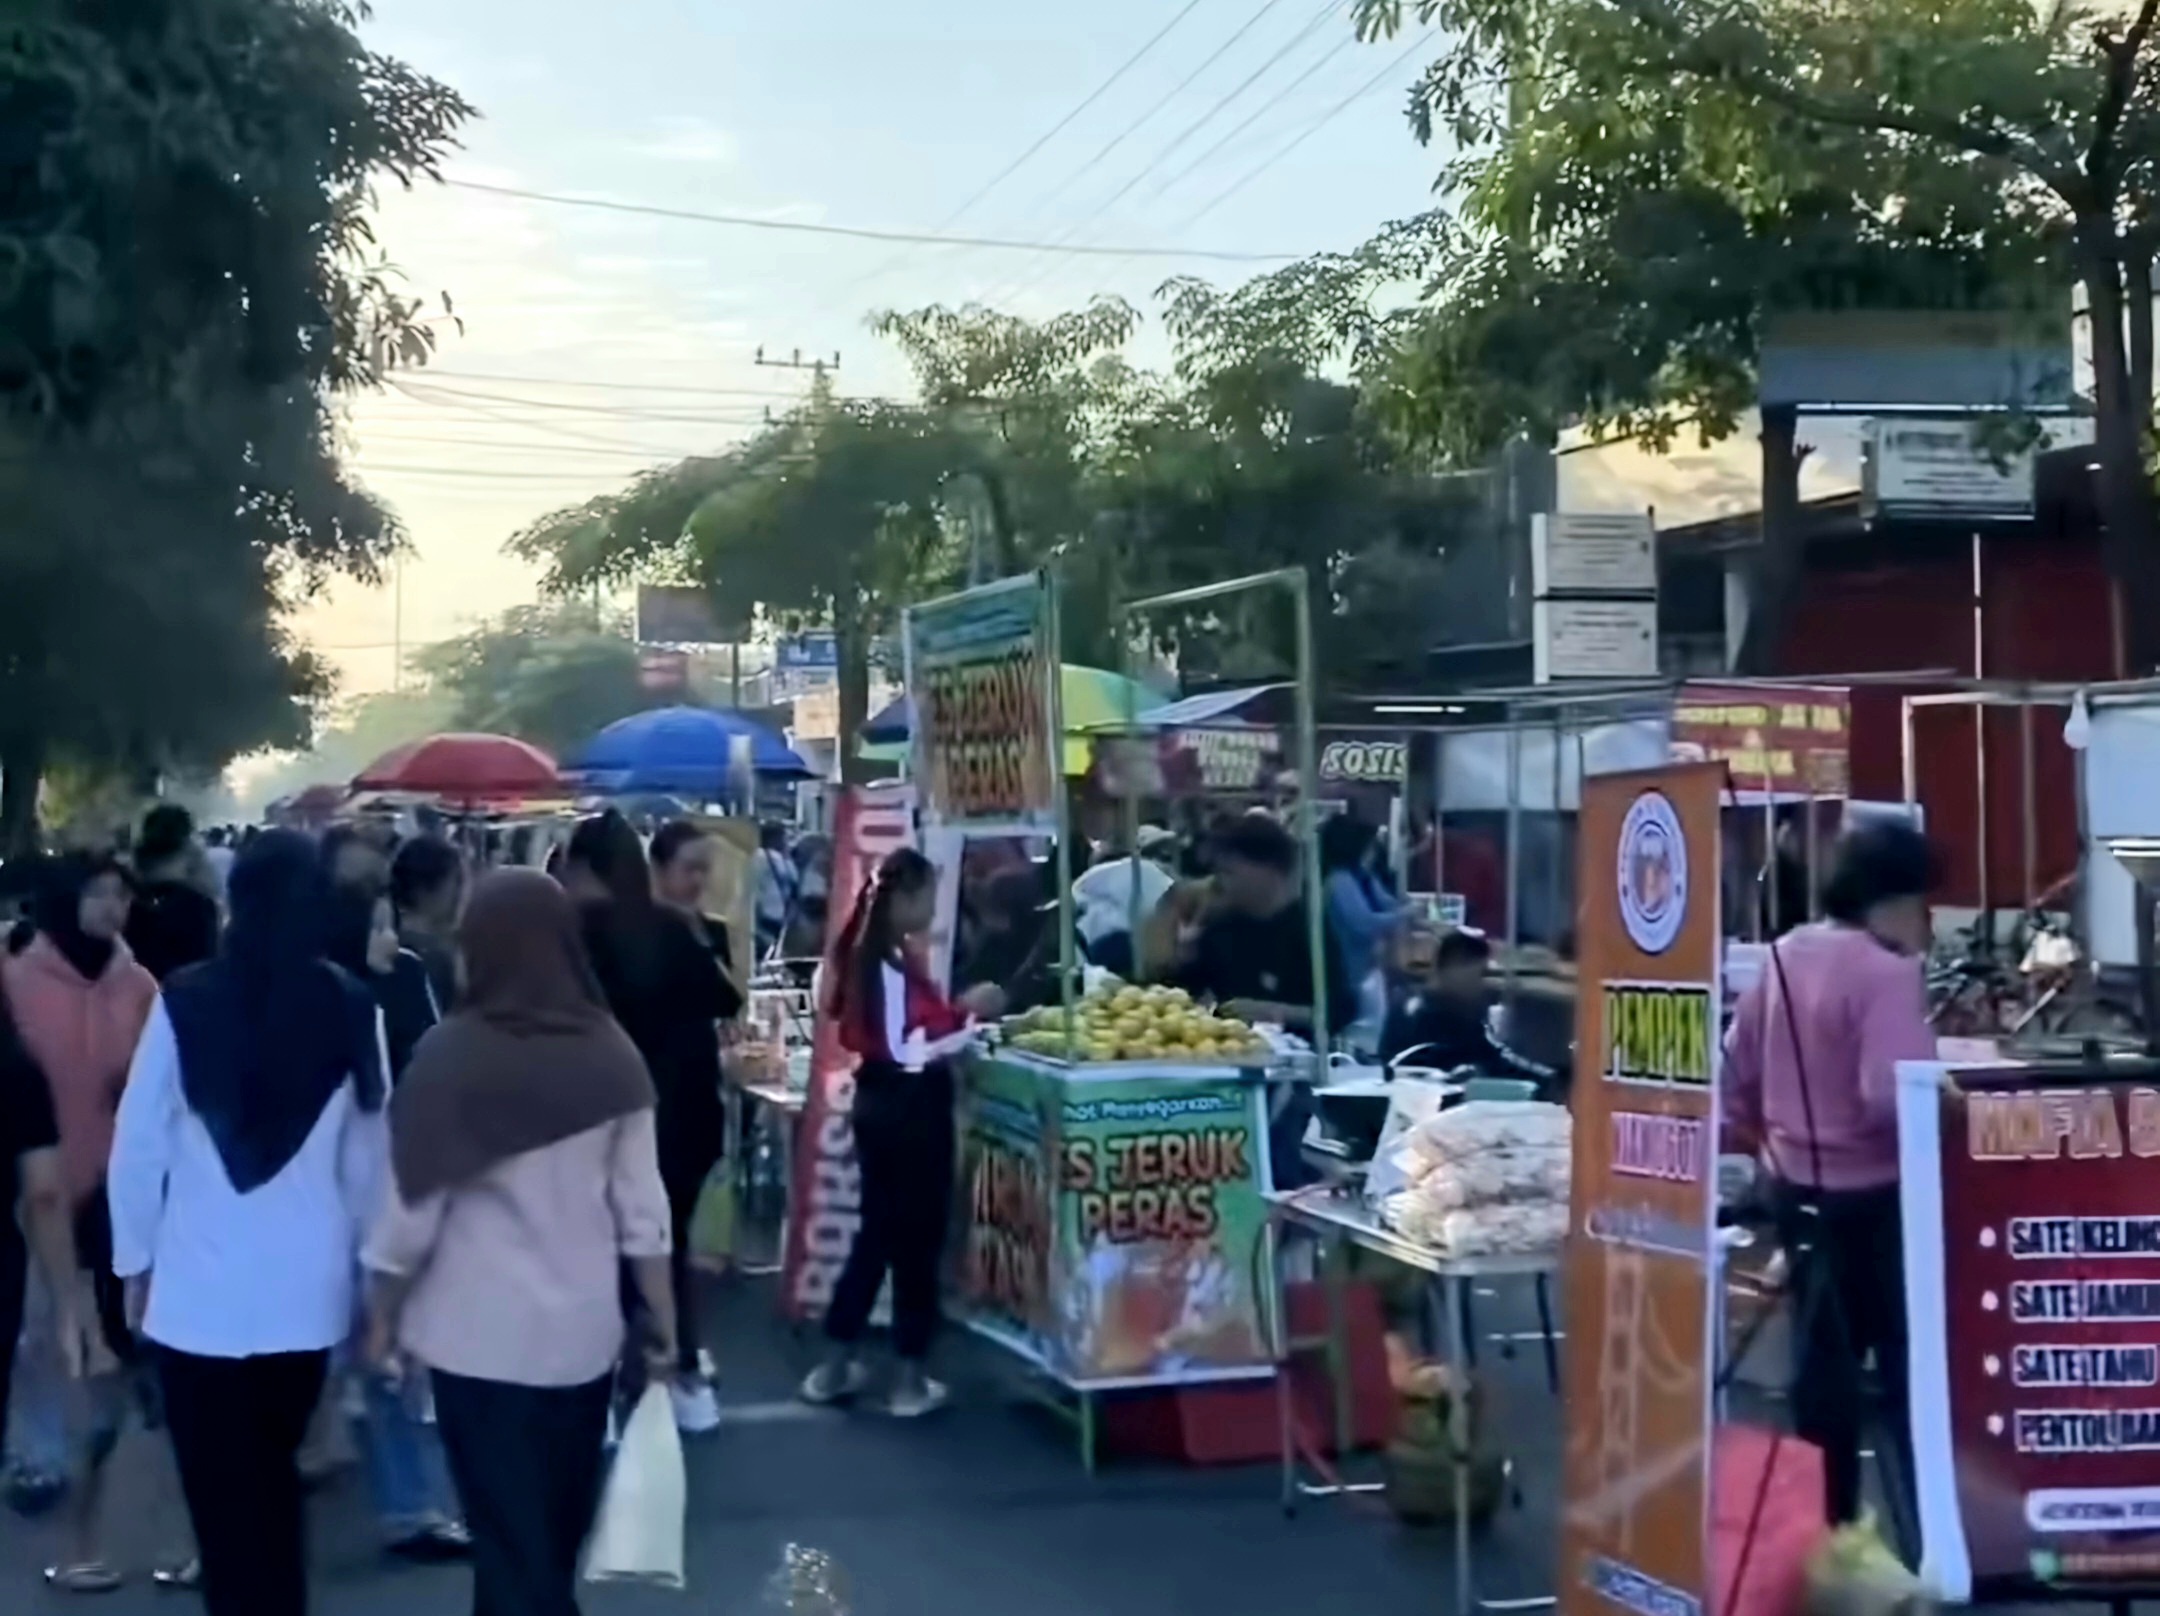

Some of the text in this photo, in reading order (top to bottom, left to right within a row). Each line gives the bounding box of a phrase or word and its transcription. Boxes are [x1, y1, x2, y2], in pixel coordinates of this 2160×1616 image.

[1107, 1127, 1249, 1188] JERUK
[1080, 1184, 1217, 1243] PERAS
[2010, 1217, 2076, 1258] SATE
[2011, 1281, 2079, 1321] SATE
[2013, 1345, 2085, 1386] SATE
